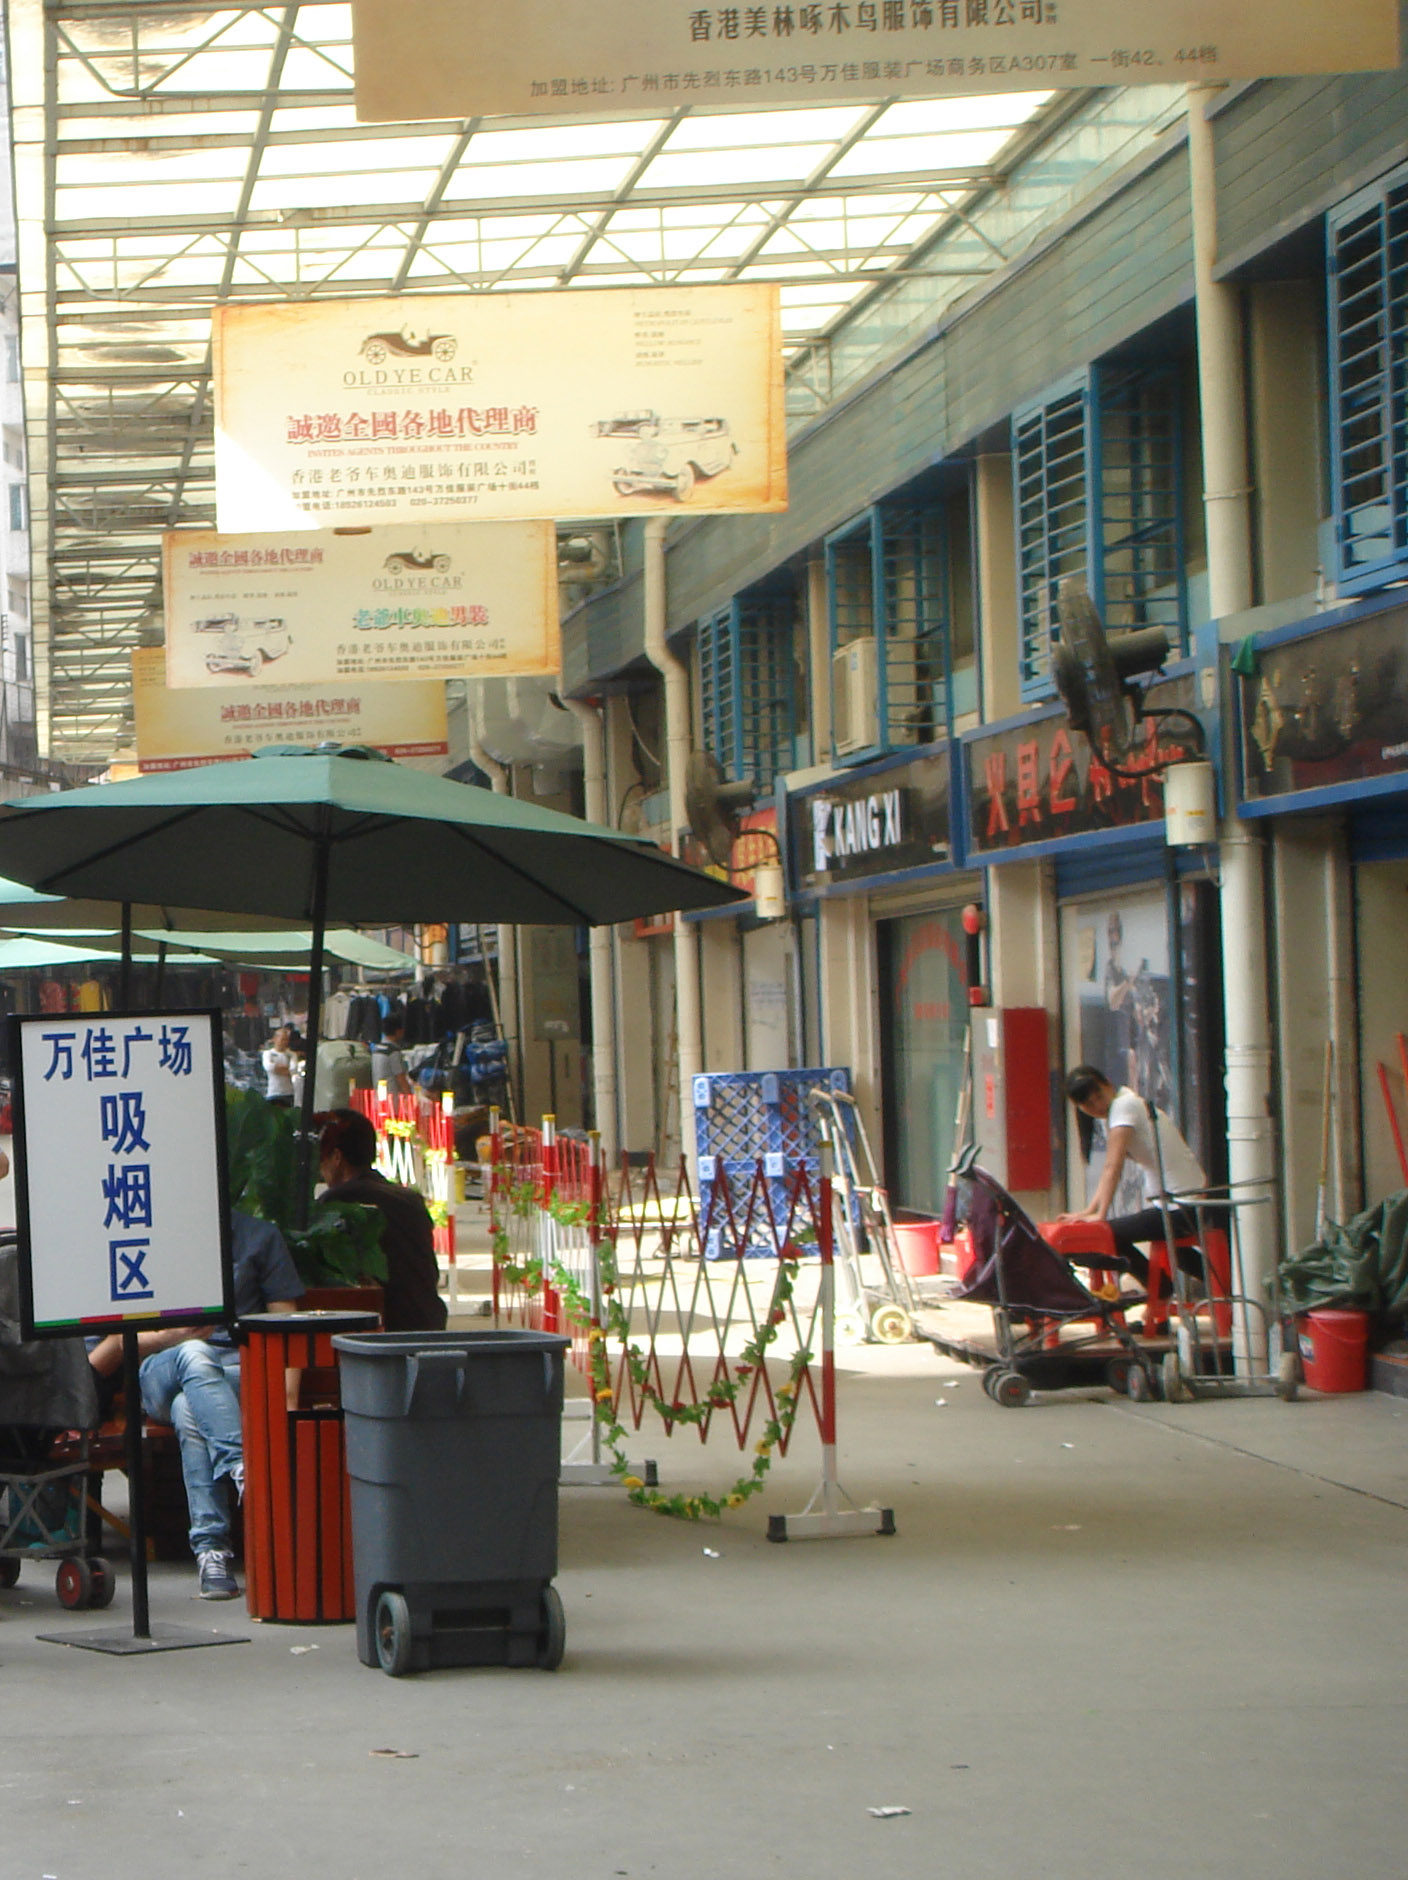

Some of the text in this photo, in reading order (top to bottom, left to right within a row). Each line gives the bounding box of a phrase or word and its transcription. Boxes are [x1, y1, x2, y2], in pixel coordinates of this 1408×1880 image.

[343, 366, 474, 386] OLD YE CAR
[287, 405, 540, 444] 誠邀全國各地代理商
[430, 576, 463, 588] CAR
[41, 1024, 193, 1082] 万佳广场
[99, 1090, 155, 1302] 吸烟区
